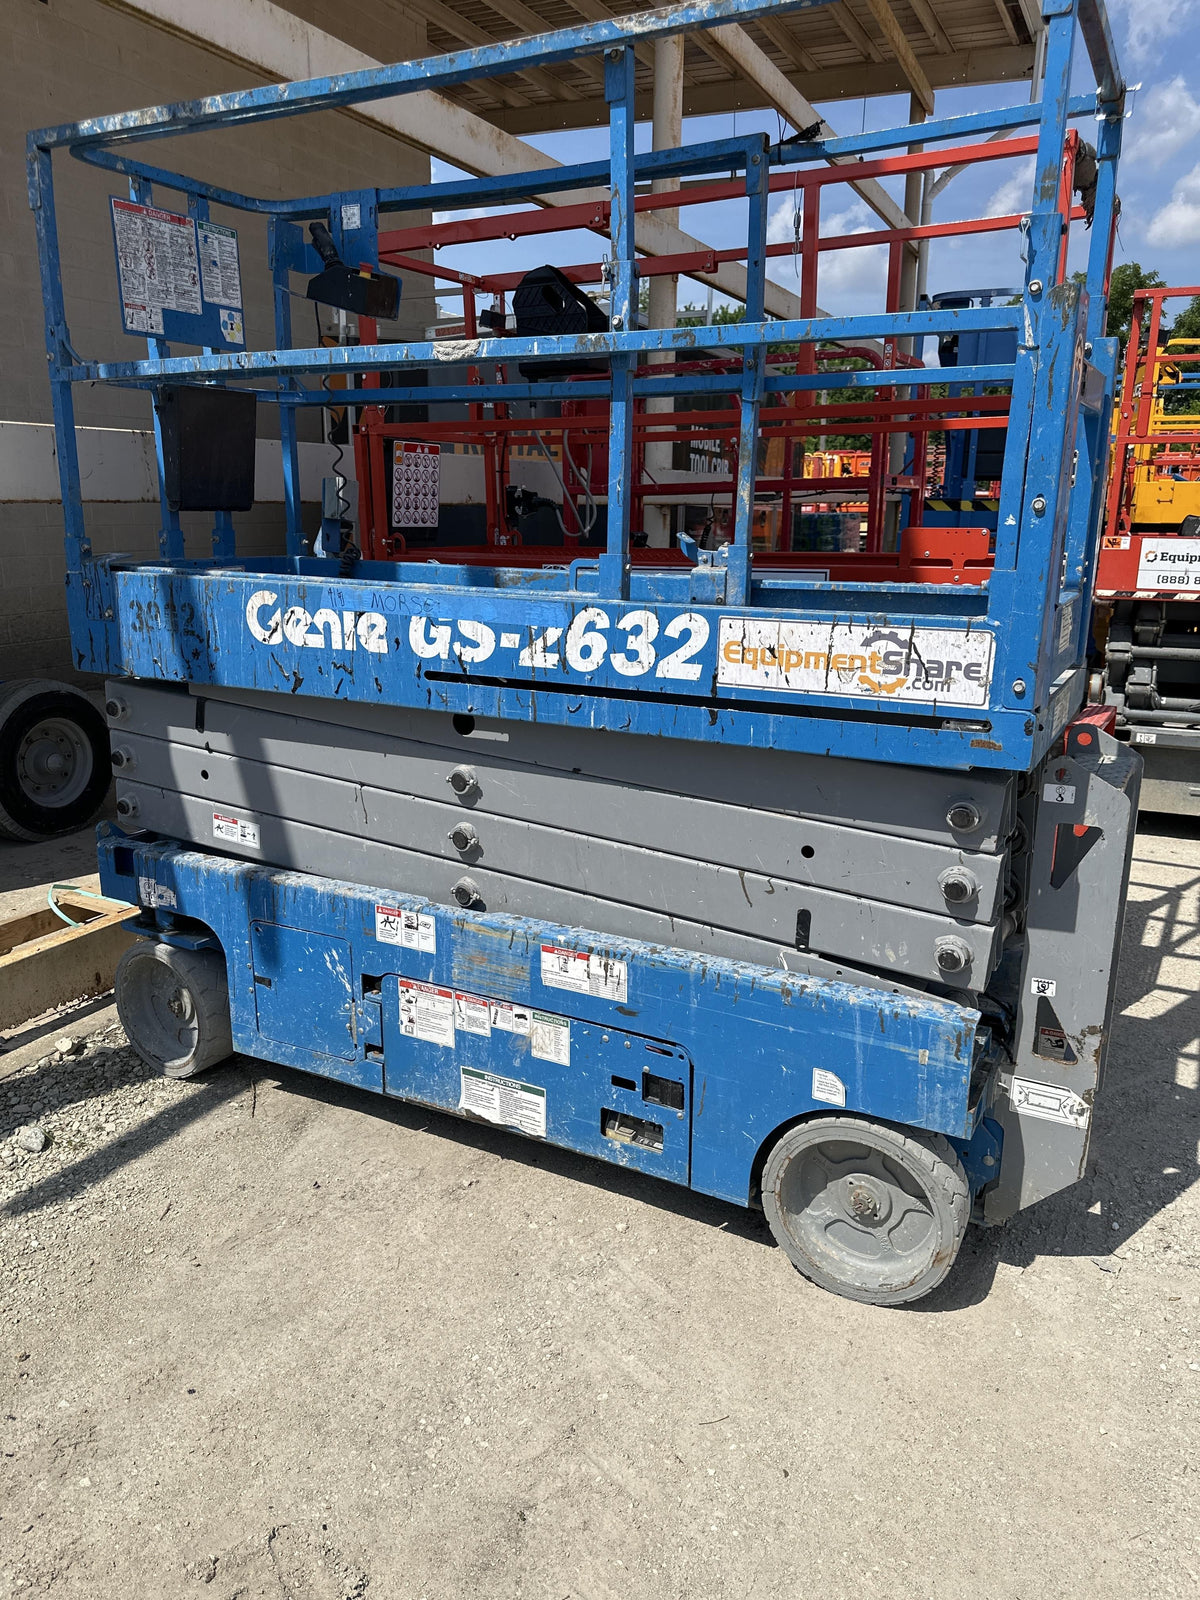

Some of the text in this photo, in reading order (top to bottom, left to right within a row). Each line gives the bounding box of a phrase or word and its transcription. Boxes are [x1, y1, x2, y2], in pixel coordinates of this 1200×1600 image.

[1157, 574, 1190, 586] (888)
[246, 590, 389, 654] Genie
[723, 640, 983, 681] EquipmentShare
[466, 996, 484, 1006] DANGER
[484, 1075, 521, 1089] INSTRUCTIONS
